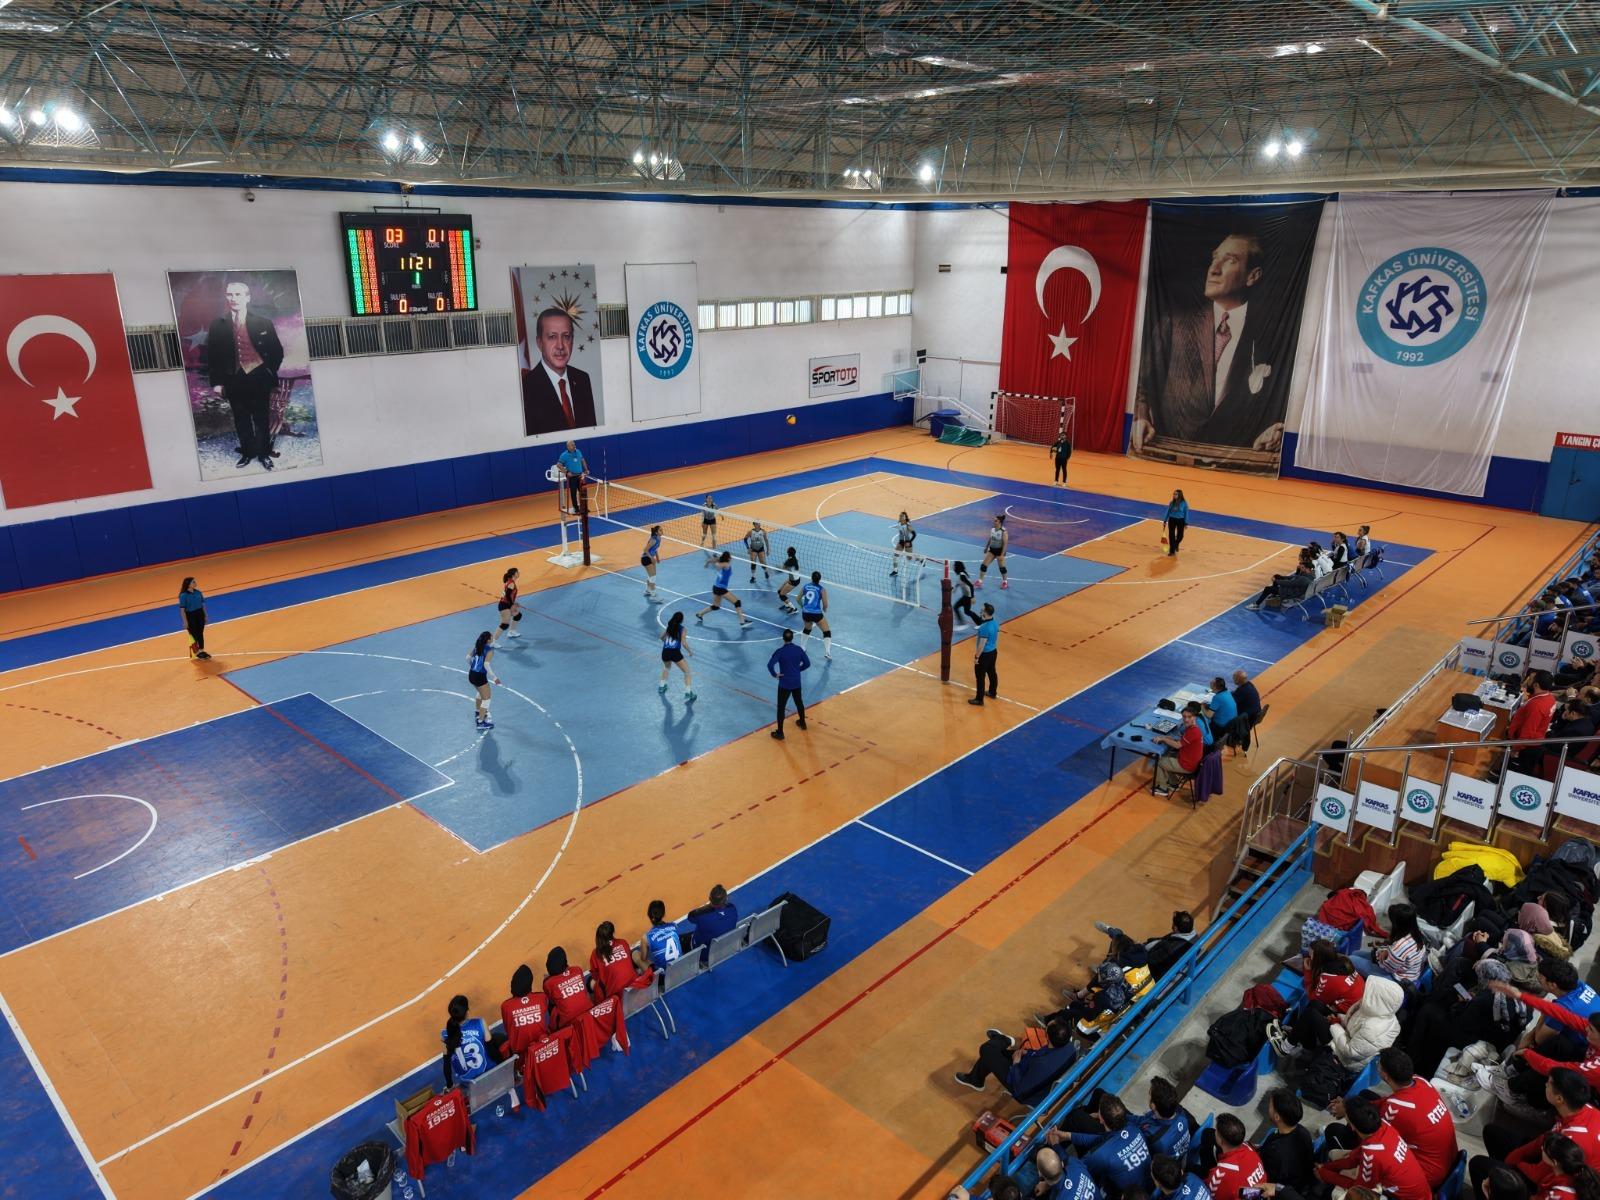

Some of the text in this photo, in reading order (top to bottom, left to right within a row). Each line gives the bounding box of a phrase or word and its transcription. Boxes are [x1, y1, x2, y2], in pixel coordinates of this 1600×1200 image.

[386, 228, 403, 243] 03
[1363, 261, 1403, 314] KAFKAS
[638, 311, 653, 352] KAFKAS
[1396, 350, 1424, 362] 1992
[1562, 434, 1591, 447] YANGIN
[1365, 797, 1389, 810] KAFKAS
[1456, 791, 1483, 804] KAFKAS
[665, 936, 680, 961] 4
[561, 980, 585, 999] 1955
[514, 1012, 542, 1027] 1955
[455, 1043, 483, 1070] 13
[535, 1046, 559, 1064] 1955
[427, 1108, 455, 1130] 1955
